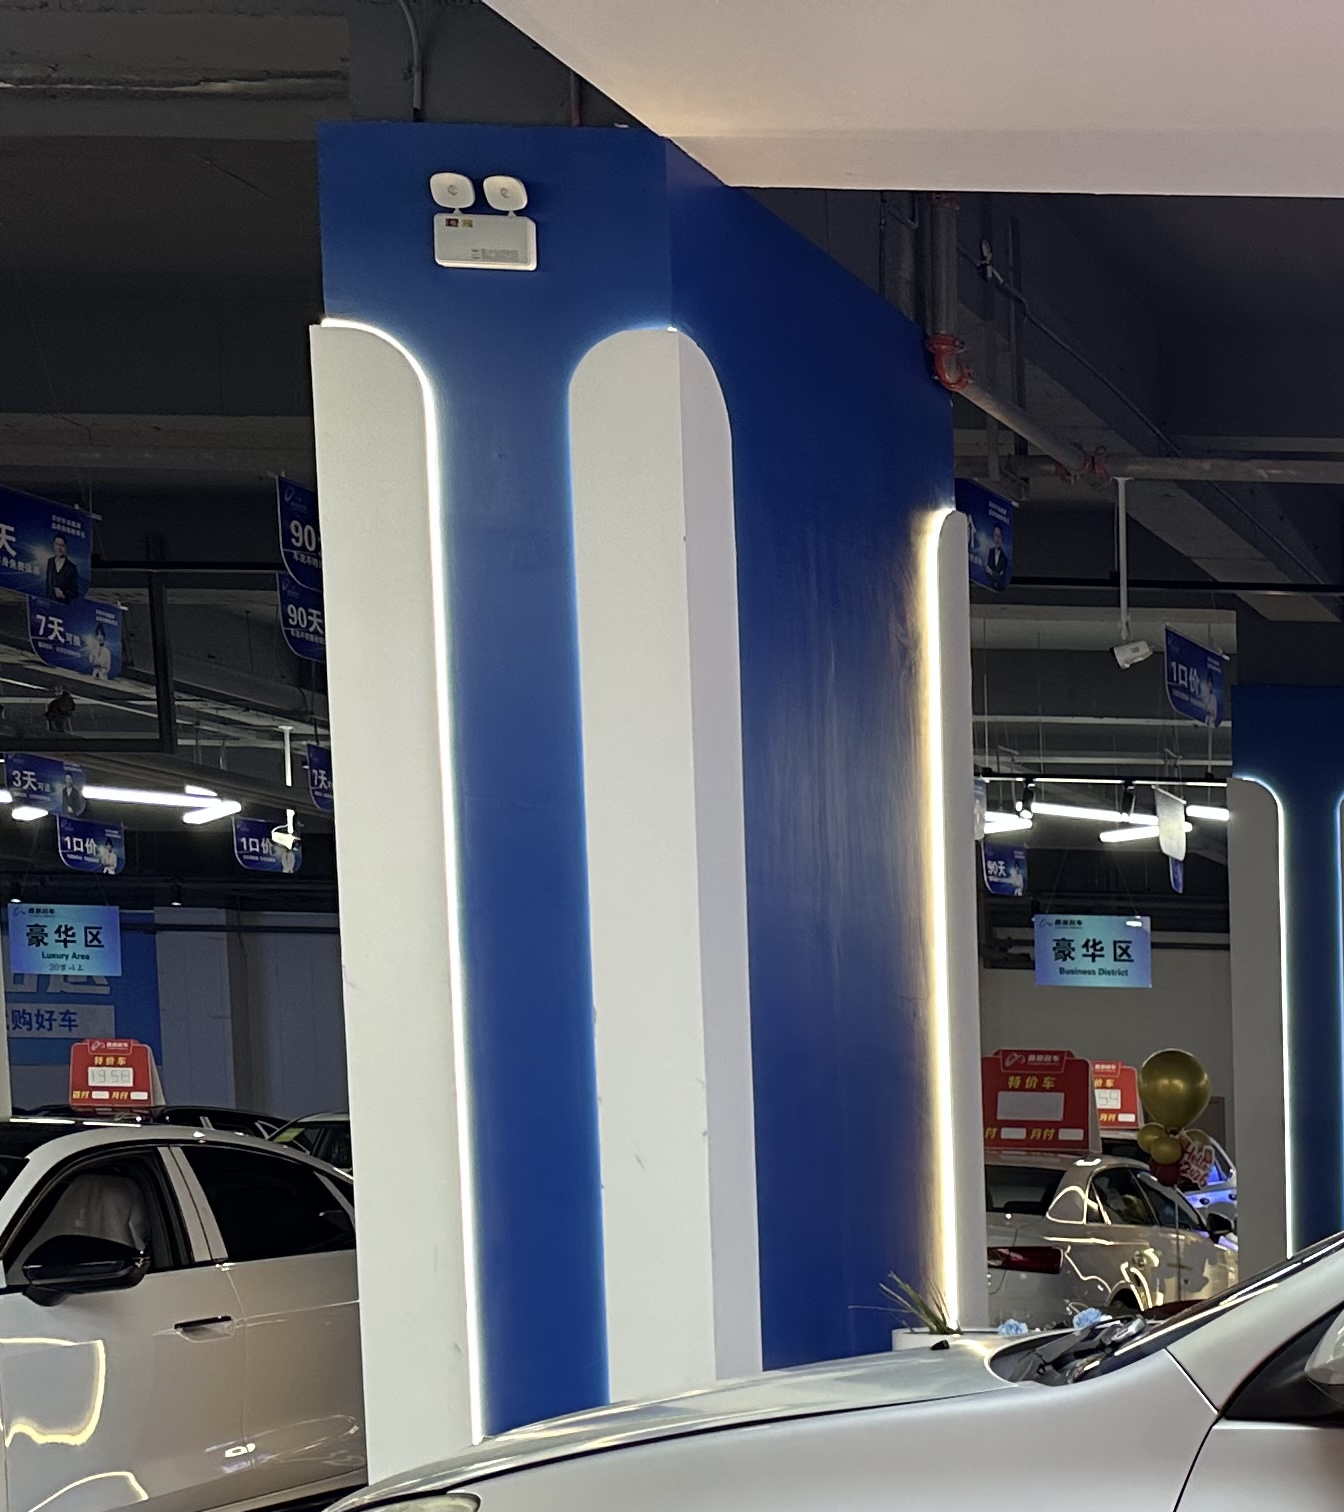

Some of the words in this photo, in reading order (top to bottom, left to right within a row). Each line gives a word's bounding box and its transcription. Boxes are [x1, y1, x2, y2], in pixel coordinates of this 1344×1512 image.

[289, 519, 321, 553] 90
[64, 836, 98, 855] 1口价
[26, 923, 105, 949] 豪华区
[41, 951, 70, 961] Luxury
[71, 951, 90, 960] Area
[1052, 937, 1134, 963] 豪华区
[1059, 967, 1096, 976] Business
[1098, 967, 1129, 977] District
[6, 1009, 79, 1033] 购好车
[1007, 1076, 1056, 1089] 特价车
[1030, 1128, 1055, 1141] 月付
